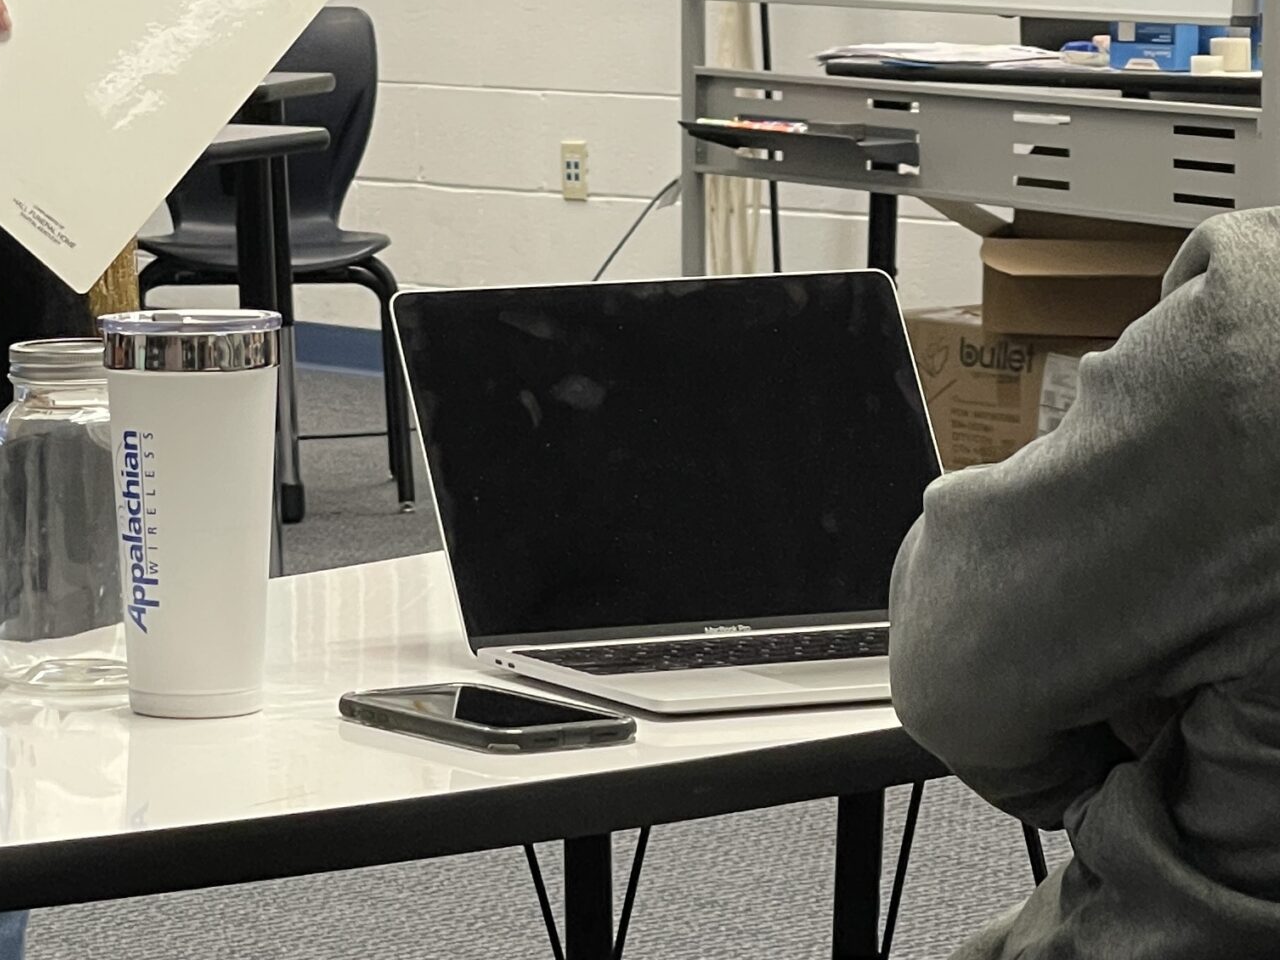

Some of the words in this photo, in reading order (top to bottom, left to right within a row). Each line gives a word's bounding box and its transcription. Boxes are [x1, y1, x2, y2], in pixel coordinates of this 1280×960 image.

[959, 336, 1034, 373] bullet
[121, 430, 160, 634] Appalachian
[143, 432, 159, 575] WIRELESS
